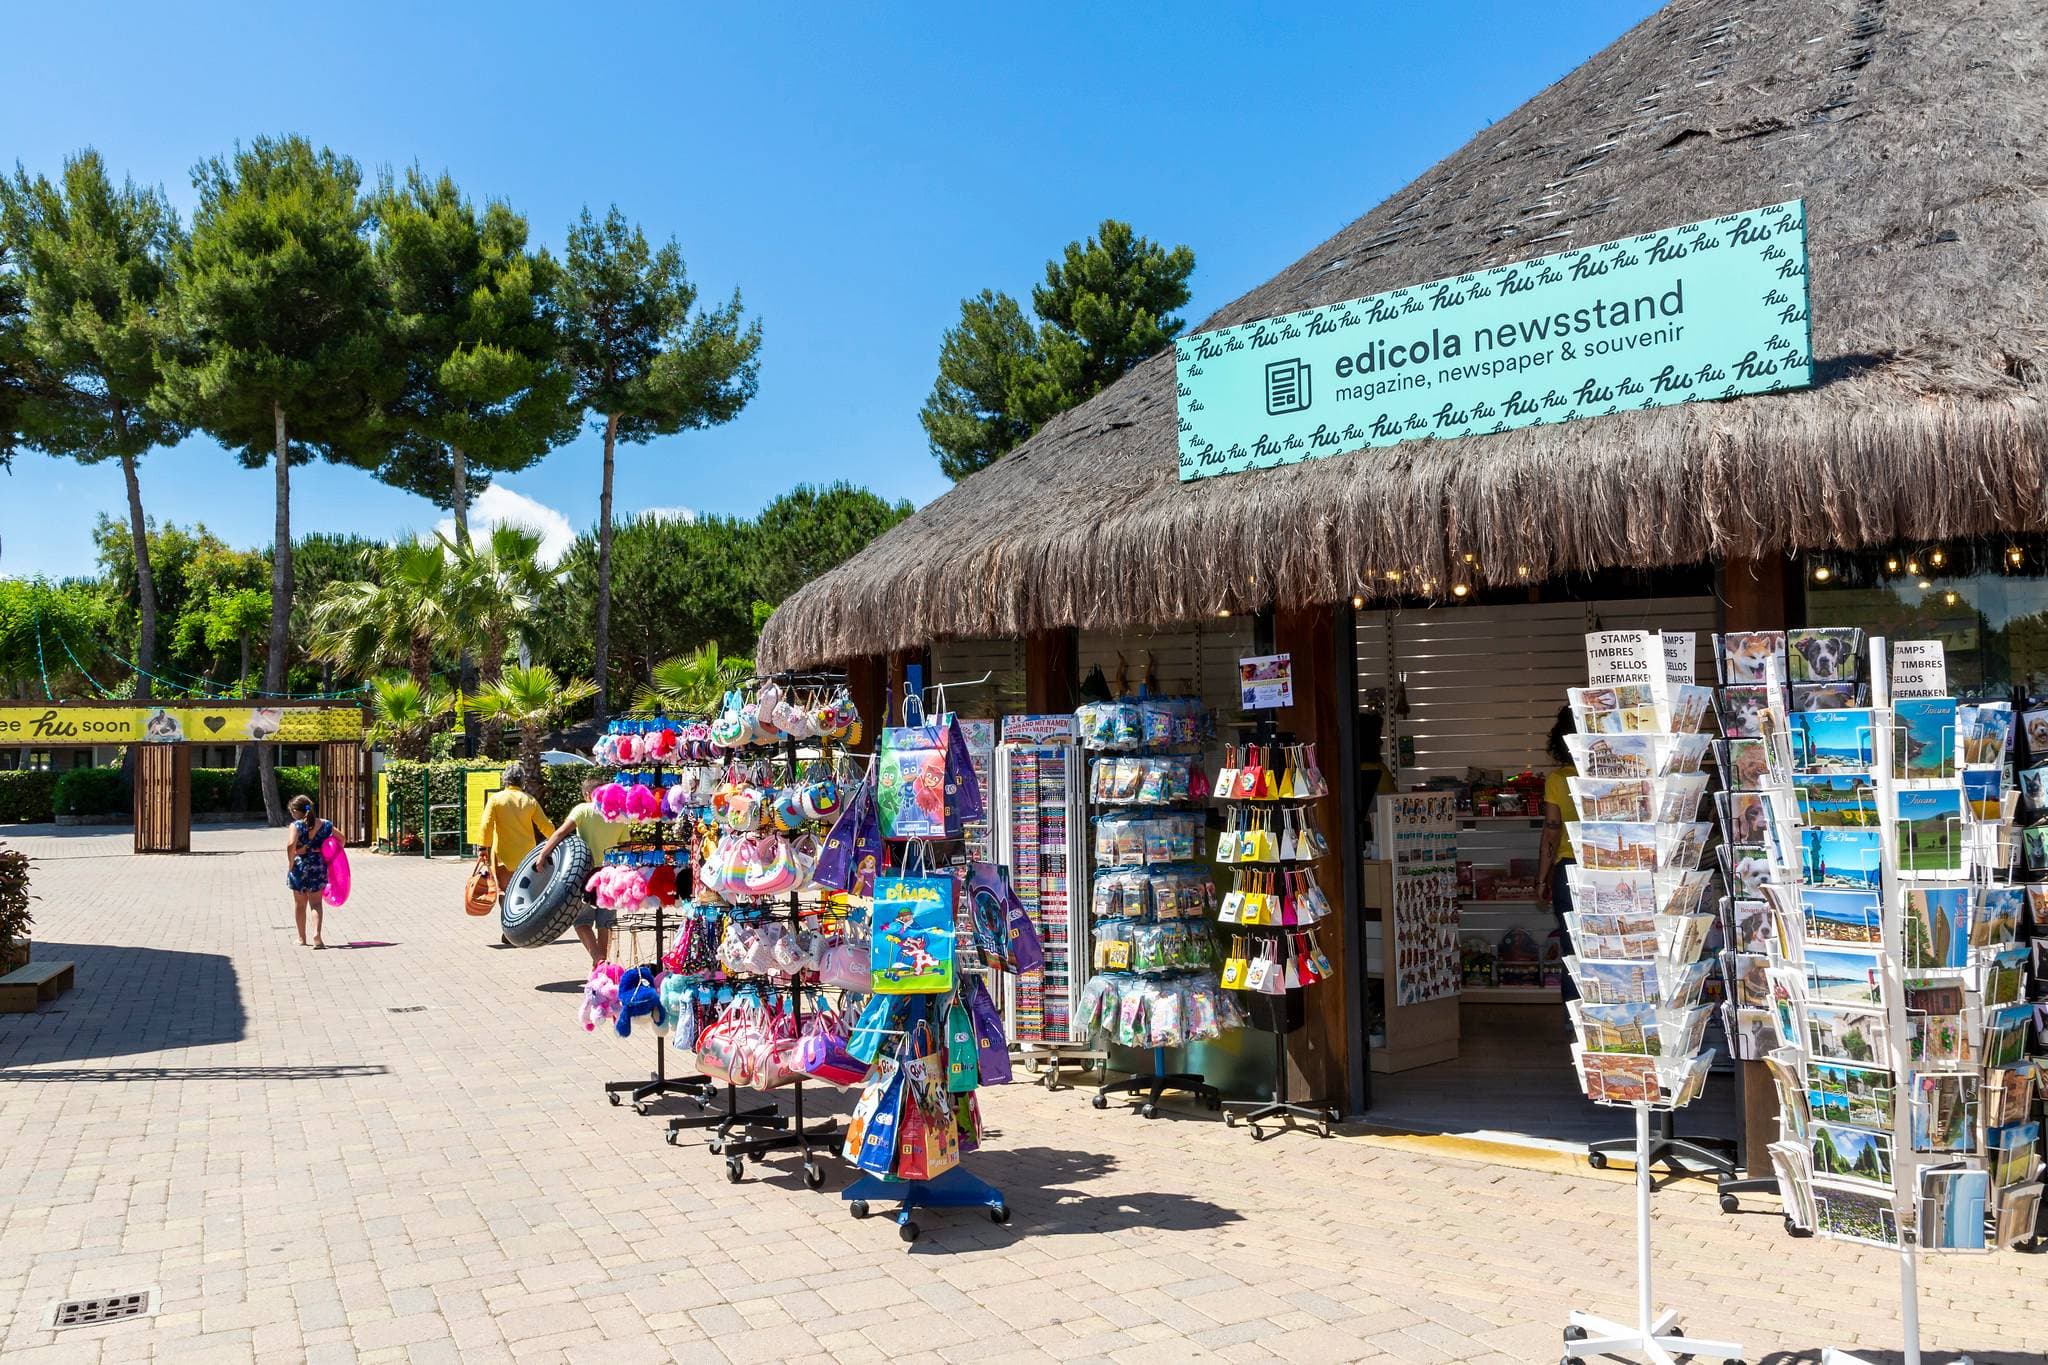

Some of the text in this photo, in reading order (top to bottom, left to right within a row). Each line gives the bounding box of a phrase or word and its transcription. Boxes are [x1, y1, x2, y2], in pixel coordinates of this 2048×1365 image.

[1760, 245, 1785, 261] hu
[1194, 338, 1223, 361] hu
[1224, 336, 1244, 352] hu
[1248, 326, 1278, 349] hu
[1280, 324, 1300, 340] hu
[1305, 313, 1336, 337] hu
[1338, 311, 1360, 328] hu
[1365, 299, 1398, 324] hu
[1400, 297, 1424, 314] hu
[1429, 285, 1464, 311] hu
[1466, 282, 1491, 300] hu
[1497, 270, 1534, 296] hu
[1536, 267, 1562, 285] hu
[1568, 253, 1608, 281] hu
[1610, 250, 1638, 269] hu
[1645, 236, 1687, 265] hu
[1690, 233, 1719, 253] hu
[1726, 218, 1771, 247] hu
[1762, 289, 1788, 306] hu
[1336, 279, 1683, 378] edicola newsstand
[1764, 334, 1790, 351] hu
[1336, 322, 1684, 402] magazine, newspaper & souvenir
[1187, 364, 1203, 377] hu
[1188, 399, 1204, 412] hu
[1197, 444, 1225, 466] hu
[1227, 443, 1247, 459] hu
[1251, 434, 1281, 458] hu
[1283, 434, 1304, 450] hu
[1308, 424, 1340, 448] hu
[1341, 424, 1364, 440] hu
[1369, 414, 1402, 438] hu
[1404, 413, 1427, 430] hu
[1433, 403, 1468, 428] hu
[1470, 402, 1495, 420] hu
[1501, 391, 1538, 417] hu
[1541, 390, 1567, 408] hu
[1573, 378, 1613, 406] hu
[1615, 377, 1643, 396] hu
[1650, 365, 1693, 393] hu
[1695, 364, 1725, 383] hu
[1732, 351, 1777, 380] hu
[1189, 434, 1205, 447] hu
[1600, 634, 1642, 644] STAMPS
[1589, 647, 1634, 659] TIMBRES
[1610, 660, 1648, 670] SELLOS
[1901, 660, 1943, 669] TIMBRES
[1591, 674, 1651, 685] BRIEFMARKE
[1893, 675, 1924, 684] SELLOS
[29, 711, 78, 737] hu
[82, 720, 131, 732] soon
